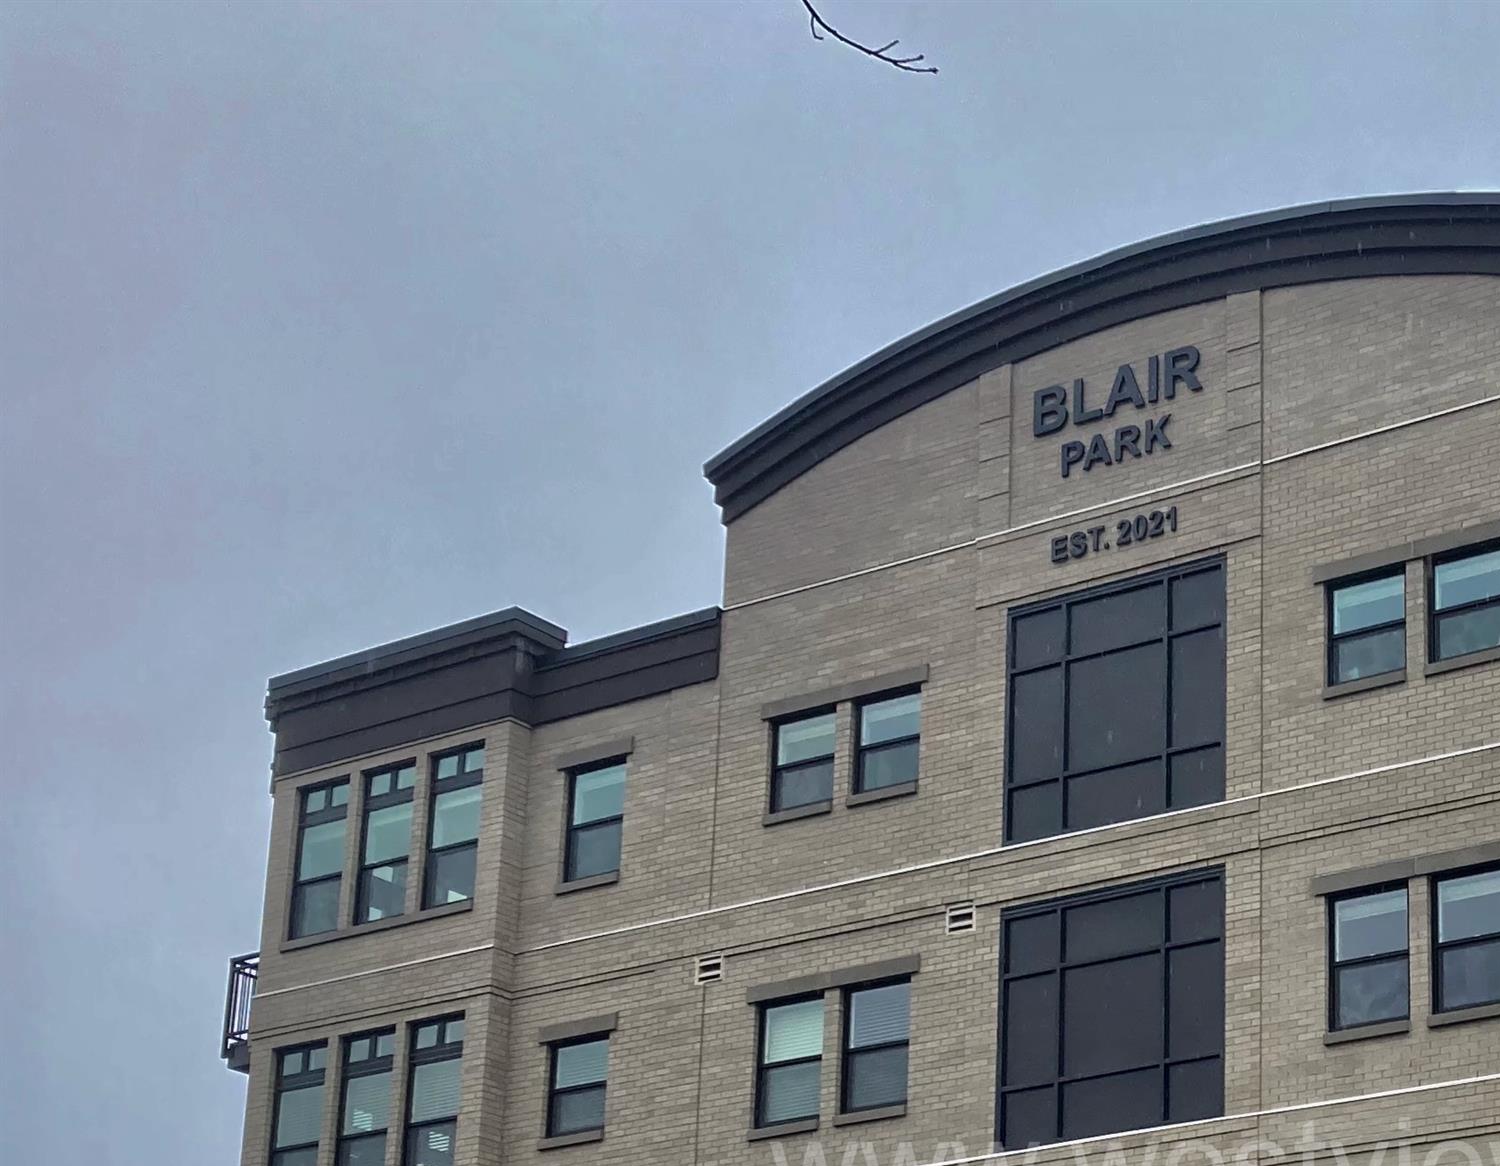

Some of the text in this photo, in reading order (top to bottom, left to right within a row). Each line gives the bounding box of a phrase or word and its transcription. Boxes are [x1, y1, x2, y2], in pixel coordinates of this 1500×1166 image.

[1033, 345, 1203, 438] BLAIR
[1061, 413, 1172, 478] PARK
[1051, 505, 1178, 563] EST. 2021
